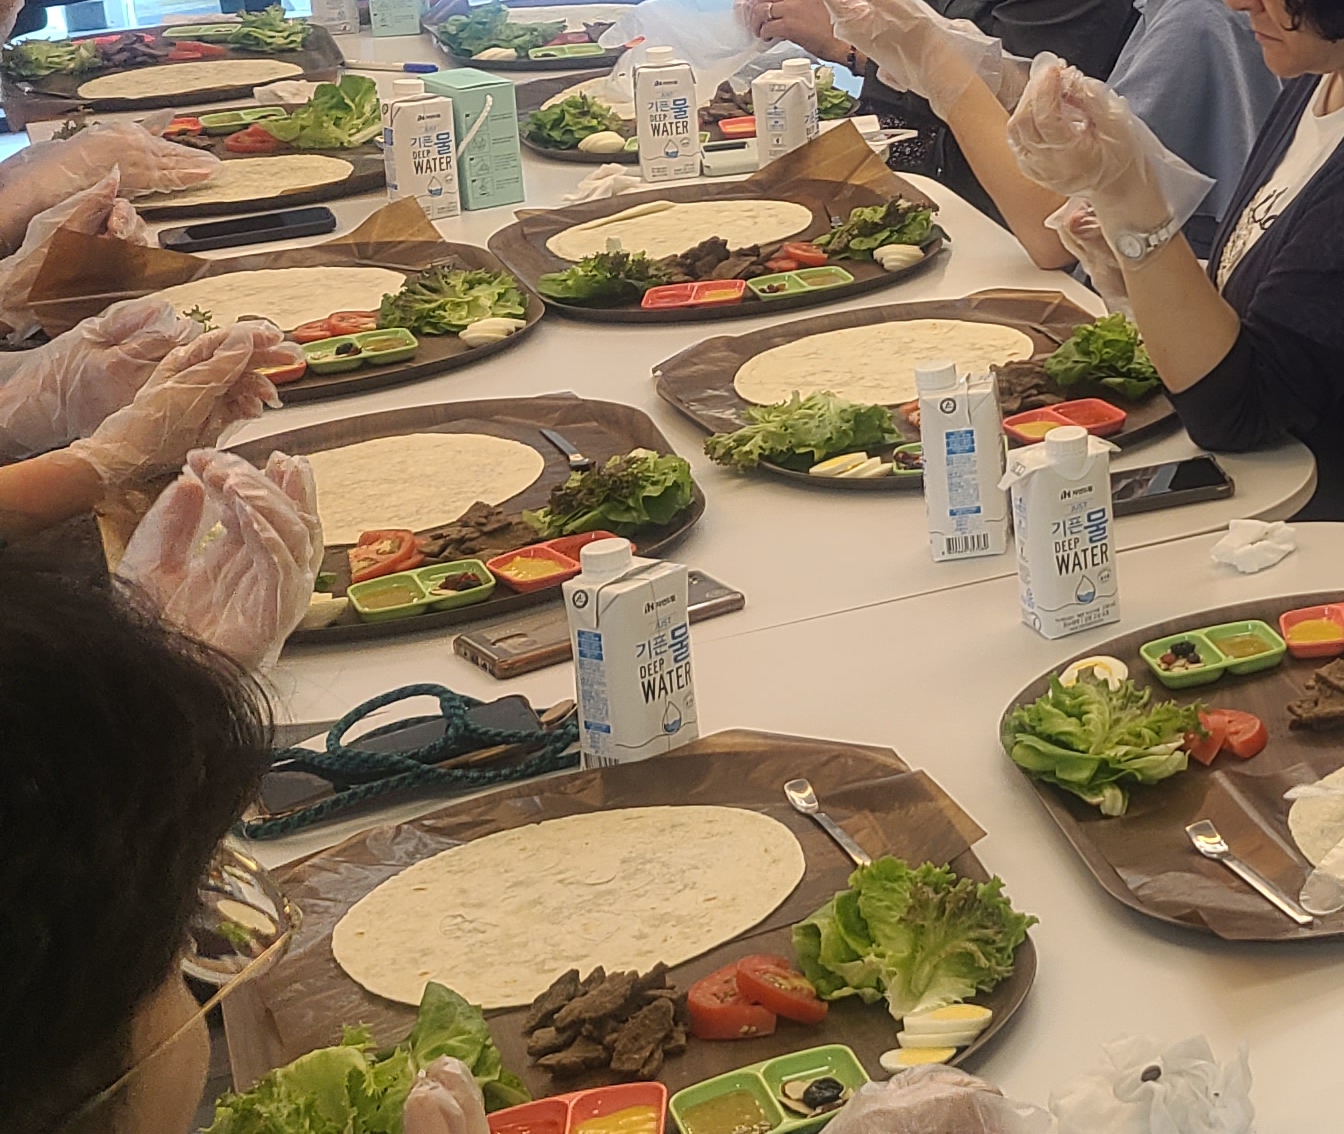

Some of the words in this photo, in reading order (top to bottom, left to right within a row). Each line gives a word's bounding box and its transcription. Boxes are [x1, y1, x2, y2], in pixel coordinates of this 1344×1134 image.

[651, 121, 688, 136] WATER
[413, 156, 452, 175] WATER
[1055, 537, 1080, 553] DEEP
[1056, 543, 1109, 576] WATER
[640, 658, 665, 679] DEEP
[641, 662, 691, 704] WATER
